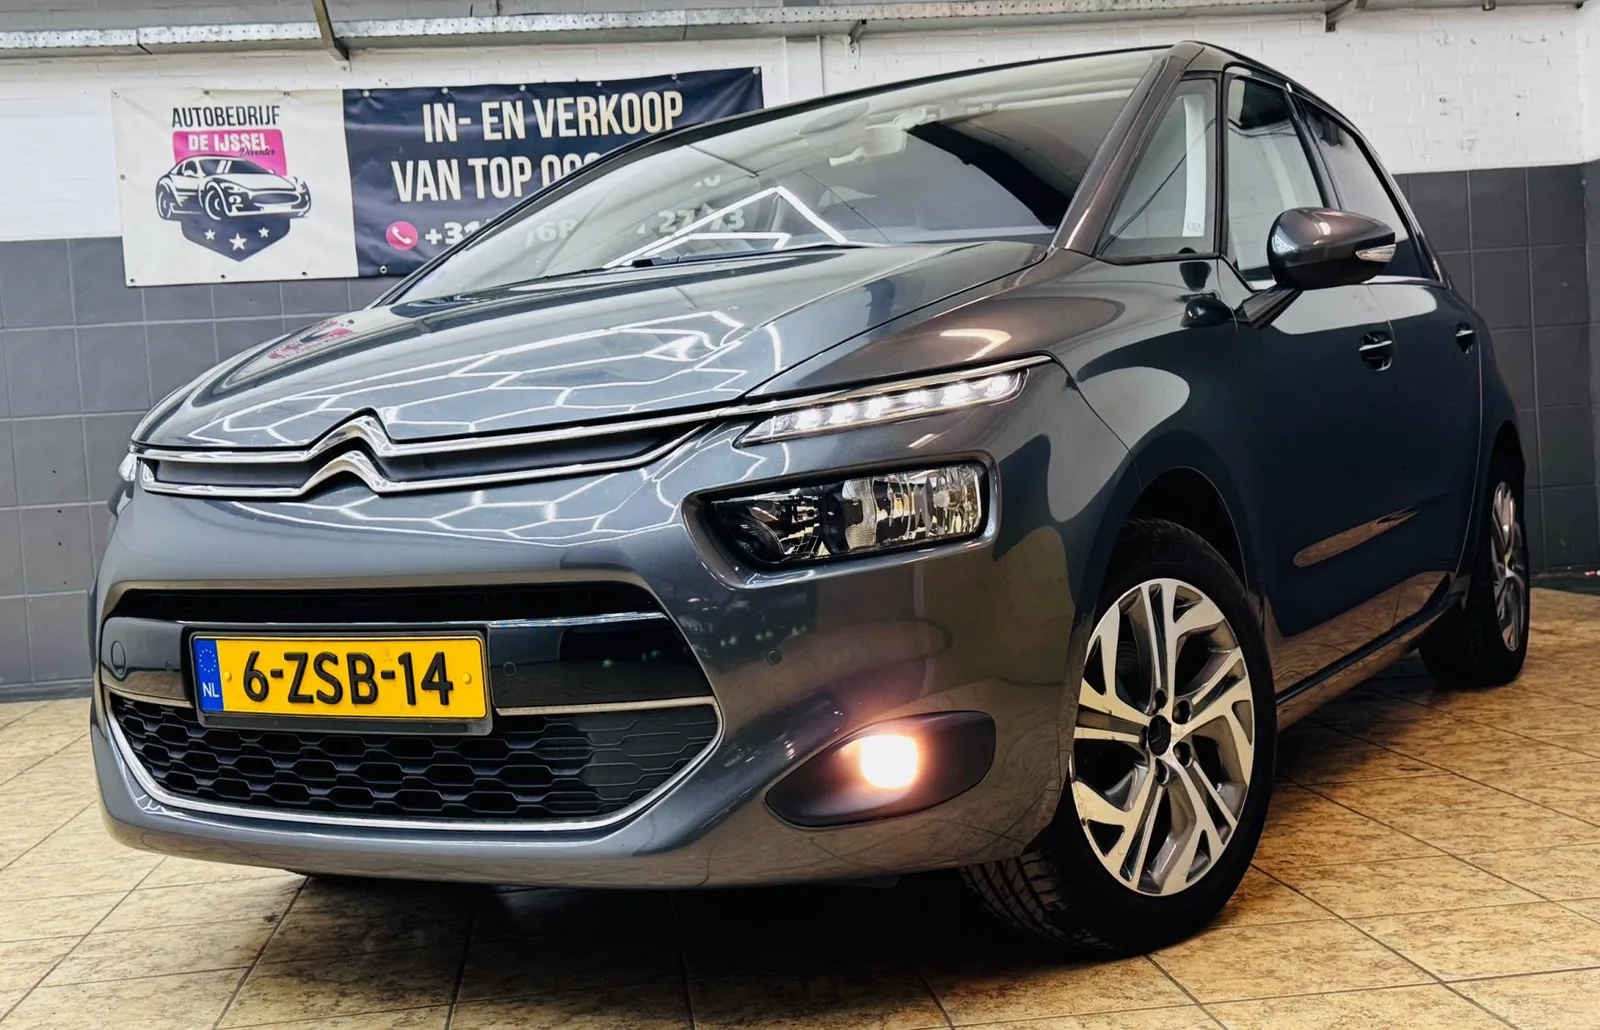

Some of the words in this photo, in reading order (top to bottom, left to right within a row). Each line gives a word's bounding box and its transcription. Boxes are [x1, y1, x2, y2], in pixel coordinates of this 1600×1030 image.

[172, 105, 281, 128] AUTOBEDRIJF
[422, 102, 471, 143] IN-
[481, 100, 526, 141] EN
[533, 90, 684, 138] VERKOOP
[187, 134, 209, 151] DE
[213, 132, 270, 152] IJSSEL
[391, 158, 462, 202] VAN
[467, 155, 532, 199] TOP
[202, 682, 220, 698] NL
[243, 650, 454, 706] 6-ZSB-14
